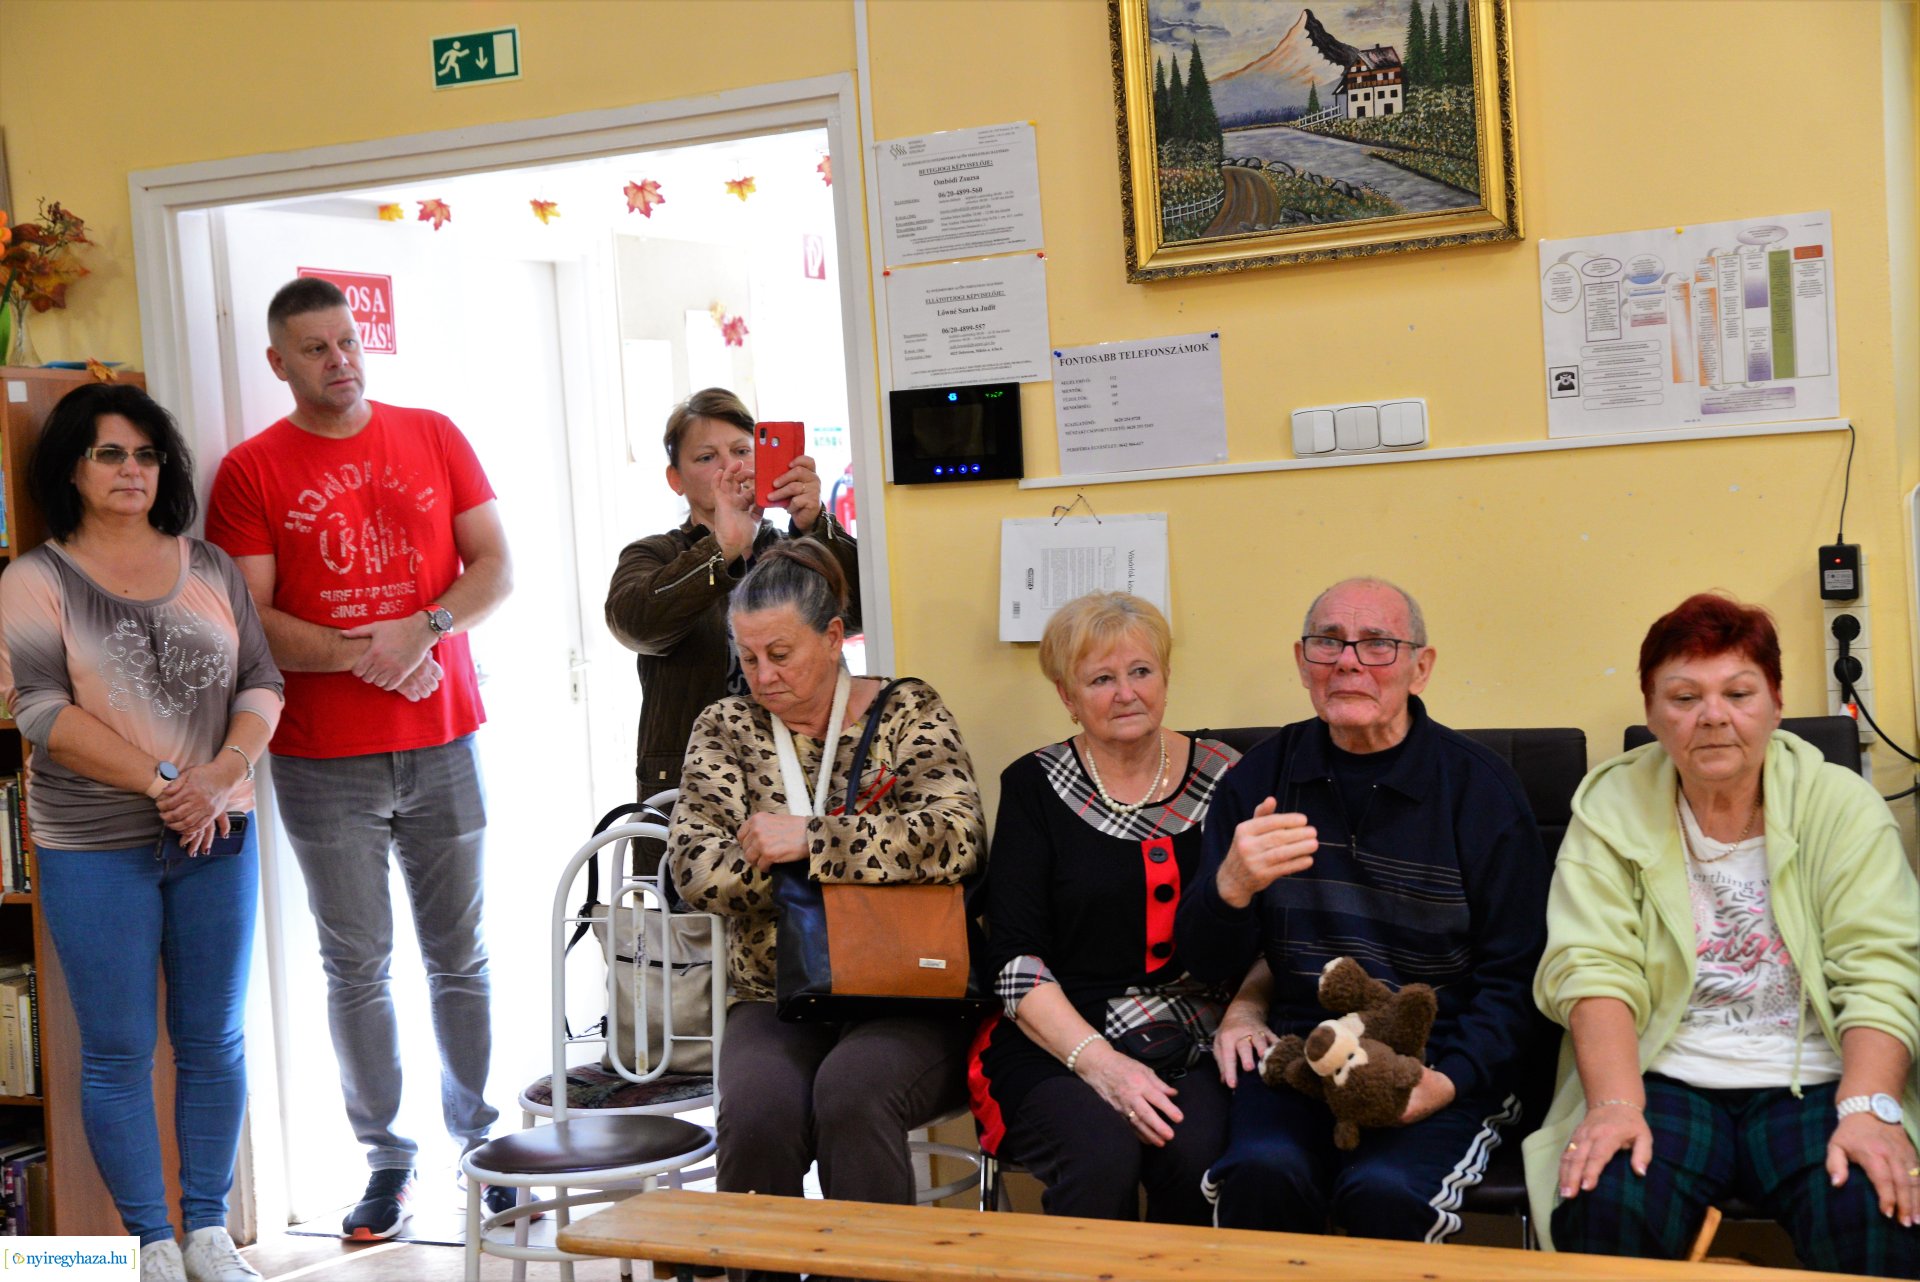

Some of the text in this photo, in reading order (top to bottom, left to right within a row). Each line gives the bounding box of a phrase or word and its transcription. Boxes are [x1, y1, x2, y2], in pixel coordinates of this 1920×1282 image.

[958, 306, 979, 314] Szarka
[980, 304, 996, 312] Judit
[359, 314, 393, 349] ZÁS!
[1060, 342, 1210, 367] FONTOSABB TELEFONSZÁMOK
